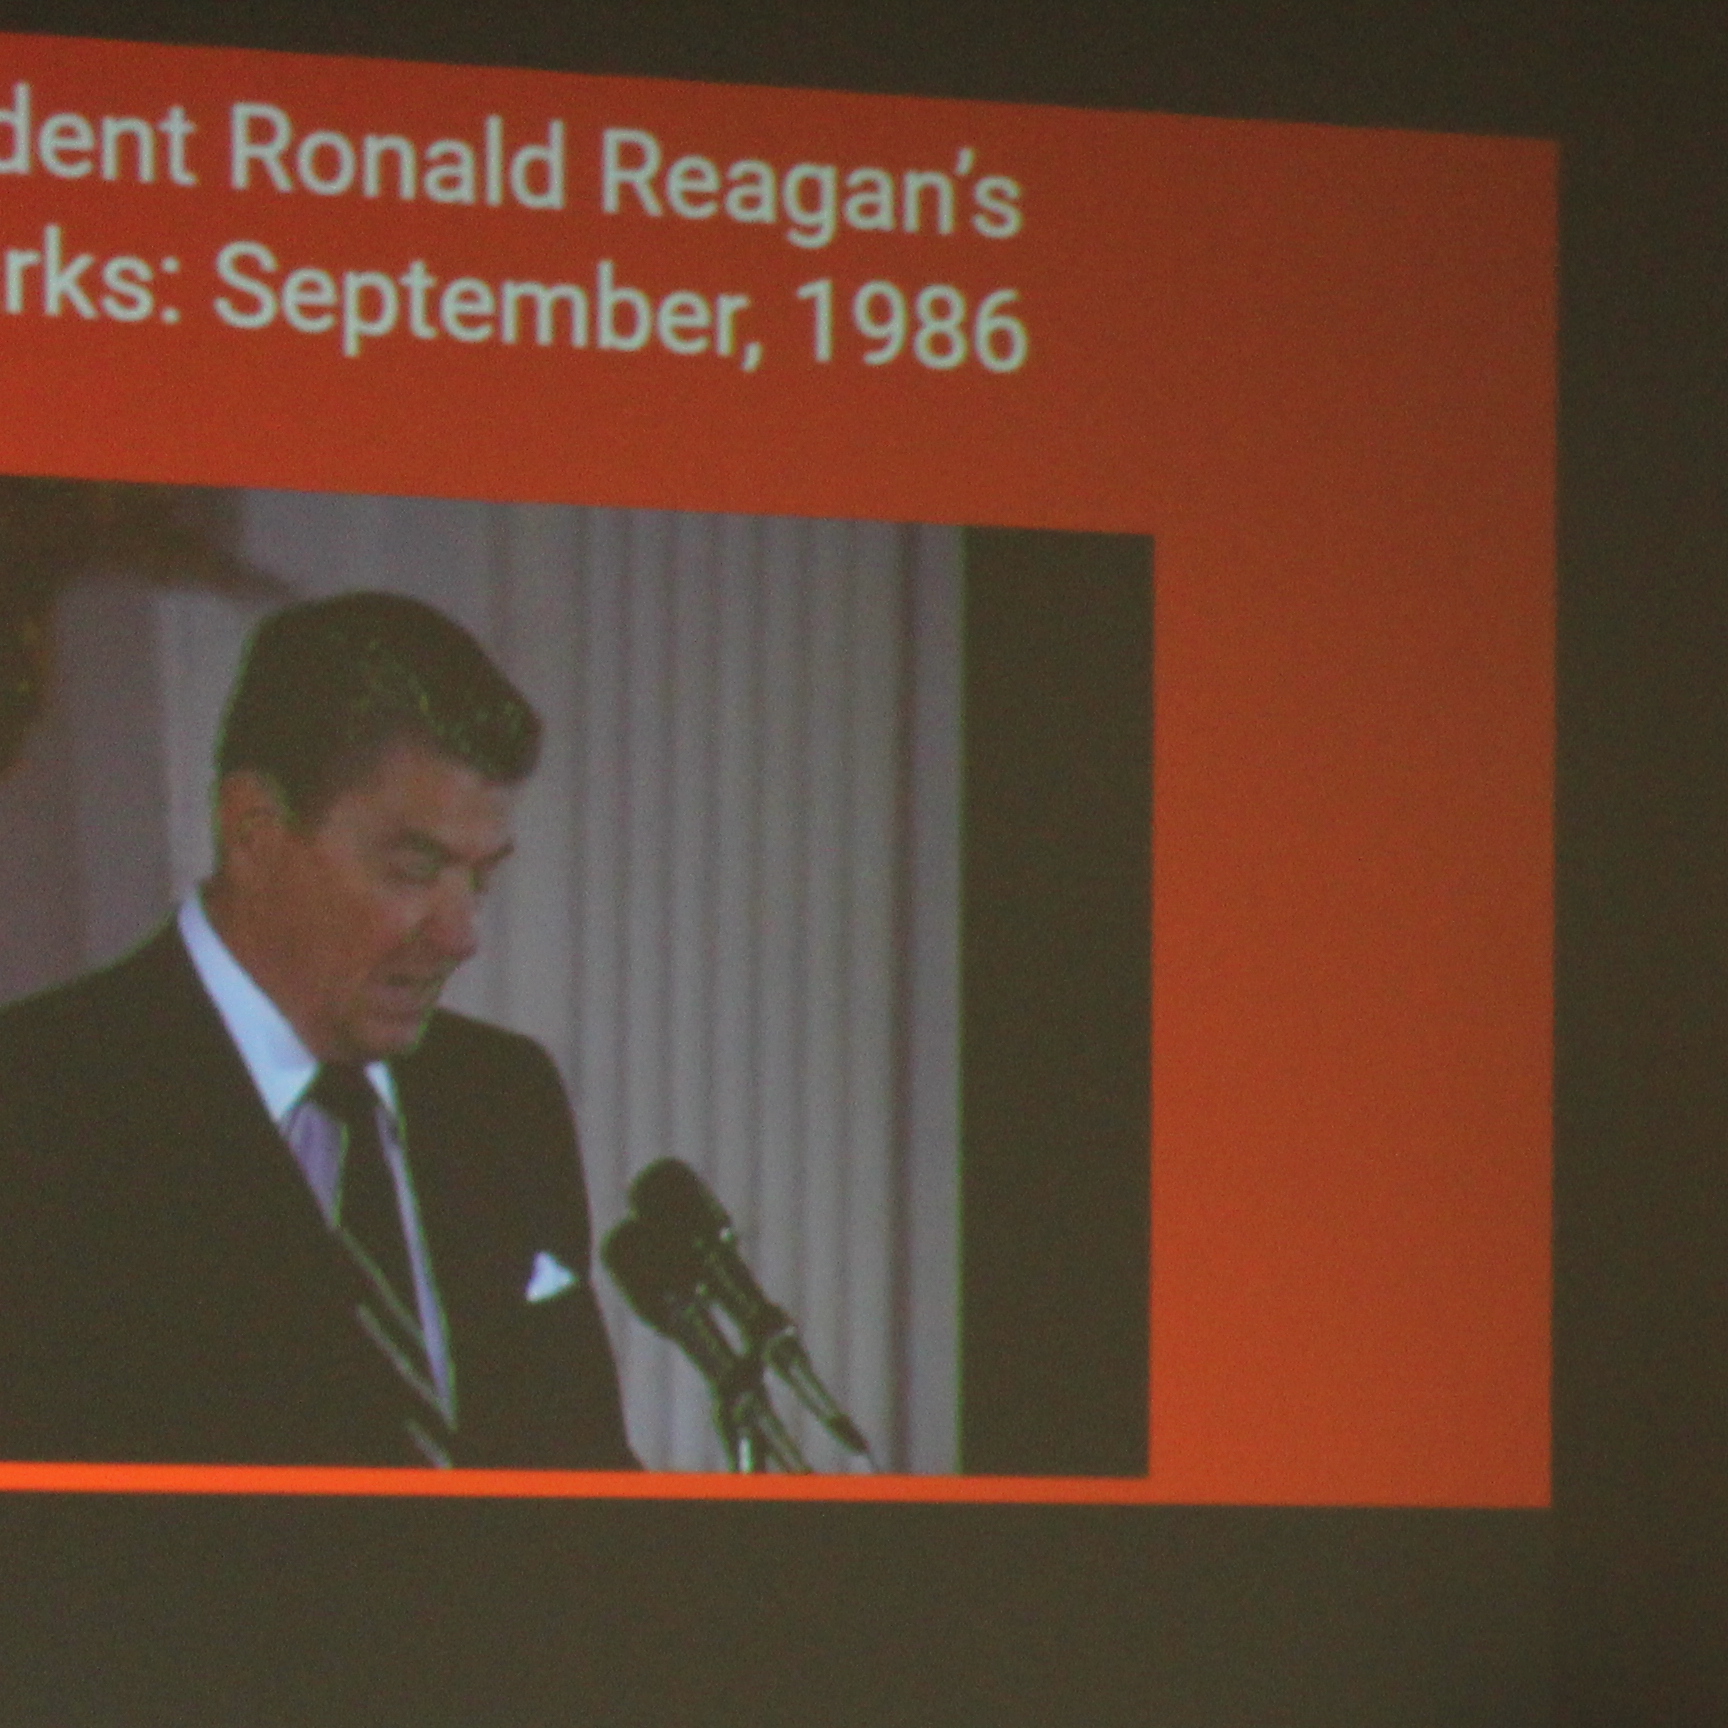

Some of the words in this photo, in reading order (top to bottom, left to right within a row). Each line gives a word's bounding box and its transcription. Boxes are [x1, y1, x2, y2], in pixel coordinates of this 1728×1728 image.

[0, 81, 199, 188] dent
[229, 101, 566, 212] Ronald
[601, 126, 1020, 250] Reagan’s
[3, 222, 182, 324] rks:
[211, 239, 762, 373] September,
[796, 277, 1028, 375] 1986
